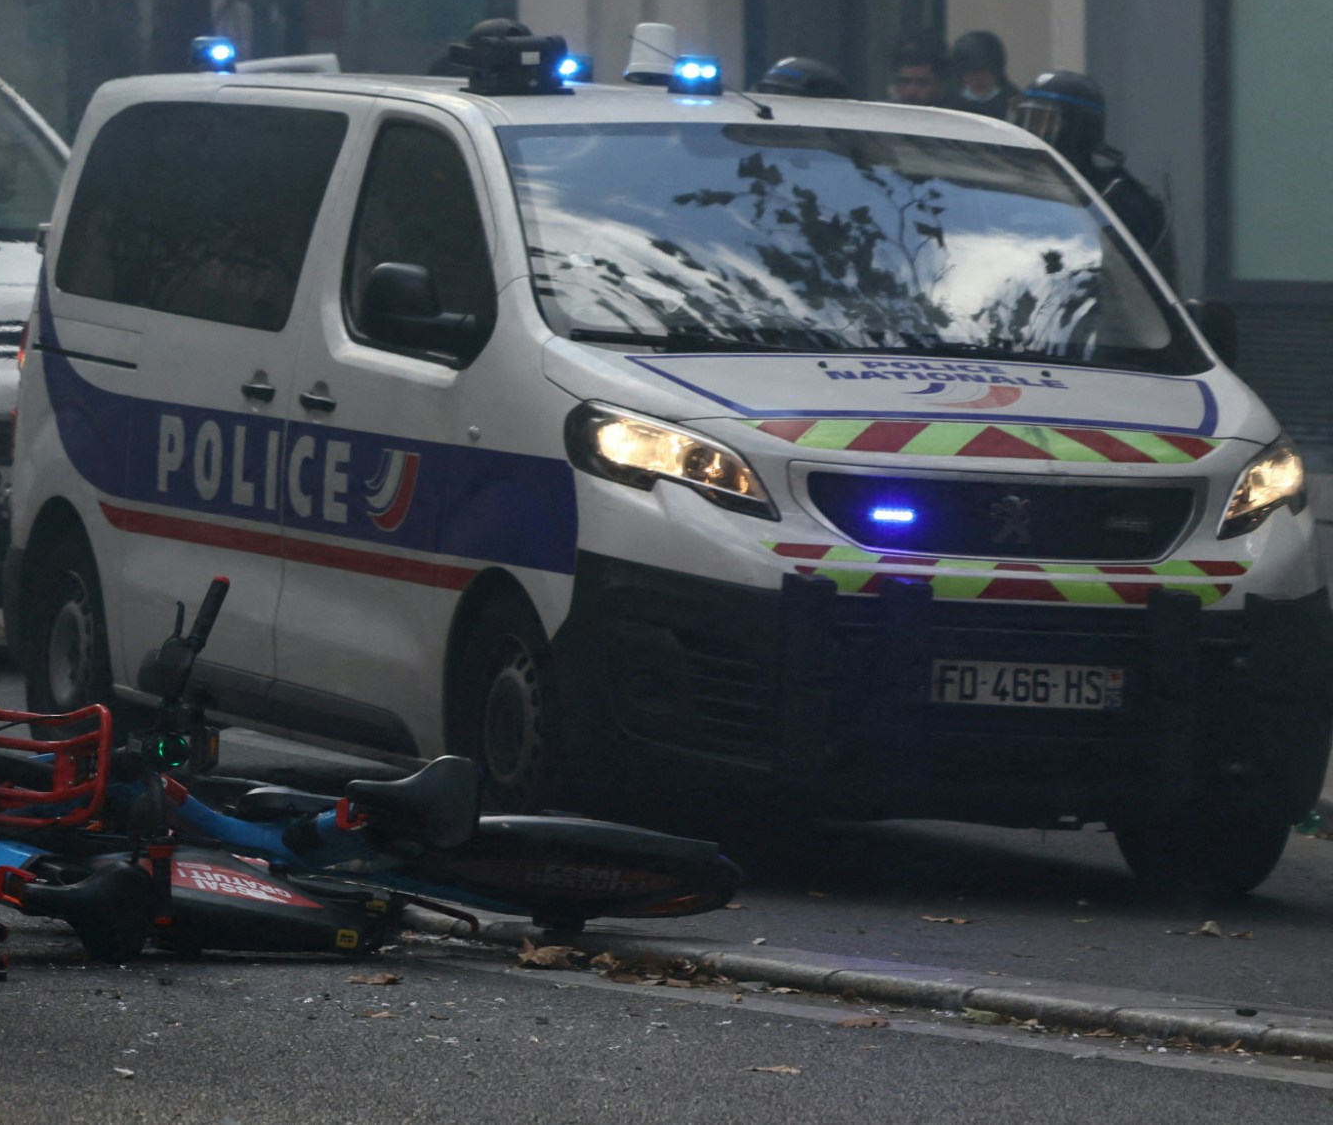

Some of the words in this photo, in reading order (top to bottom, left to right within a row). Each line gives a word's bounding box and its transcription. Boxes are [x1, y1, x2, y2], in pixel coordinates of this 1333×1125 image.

[824, 370, 1070, 390] NATIONALE
[859, 360, 1007, 374] POLICE
[157, 414, 351, 524] POLICE
[937, 664, 1104, 706] FD-466-HS
[190, 869, 292, 899] GRATUIT
